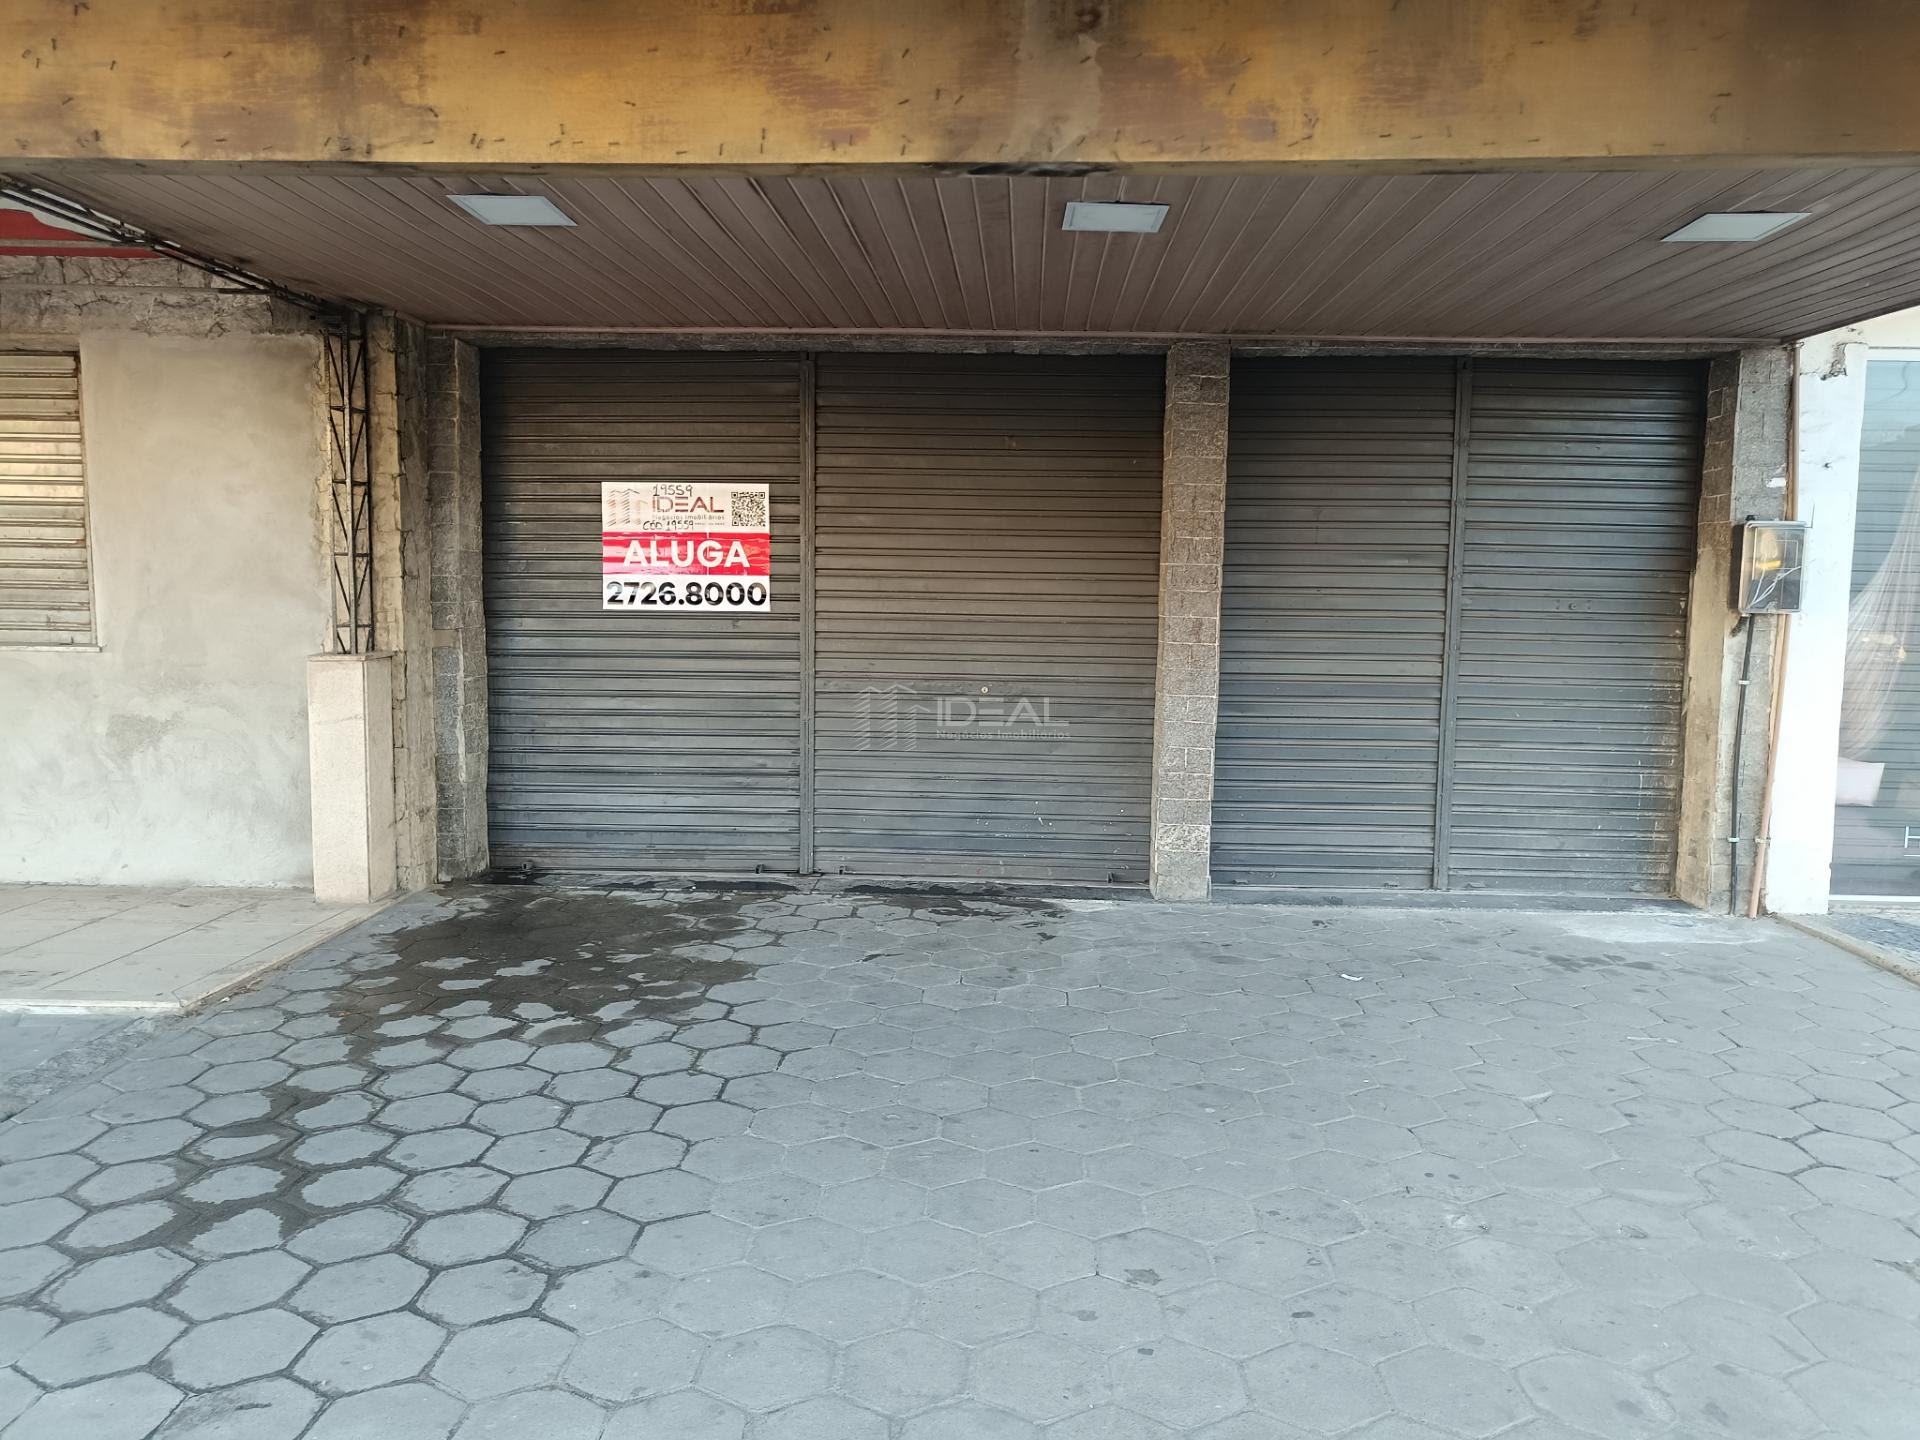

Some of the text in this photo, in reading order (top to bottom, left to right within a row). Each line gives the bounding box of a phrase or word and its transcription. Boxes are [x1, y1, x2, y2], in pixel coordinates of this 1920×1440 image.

[652, 484, 693, 497] 19559
[652, 496, 725, 513] IDEAL
[665, 519, 694, 531] 19559
[623, 540, 751, 568] ALUGA
[606, 581, 767, 606] 2726.8000
